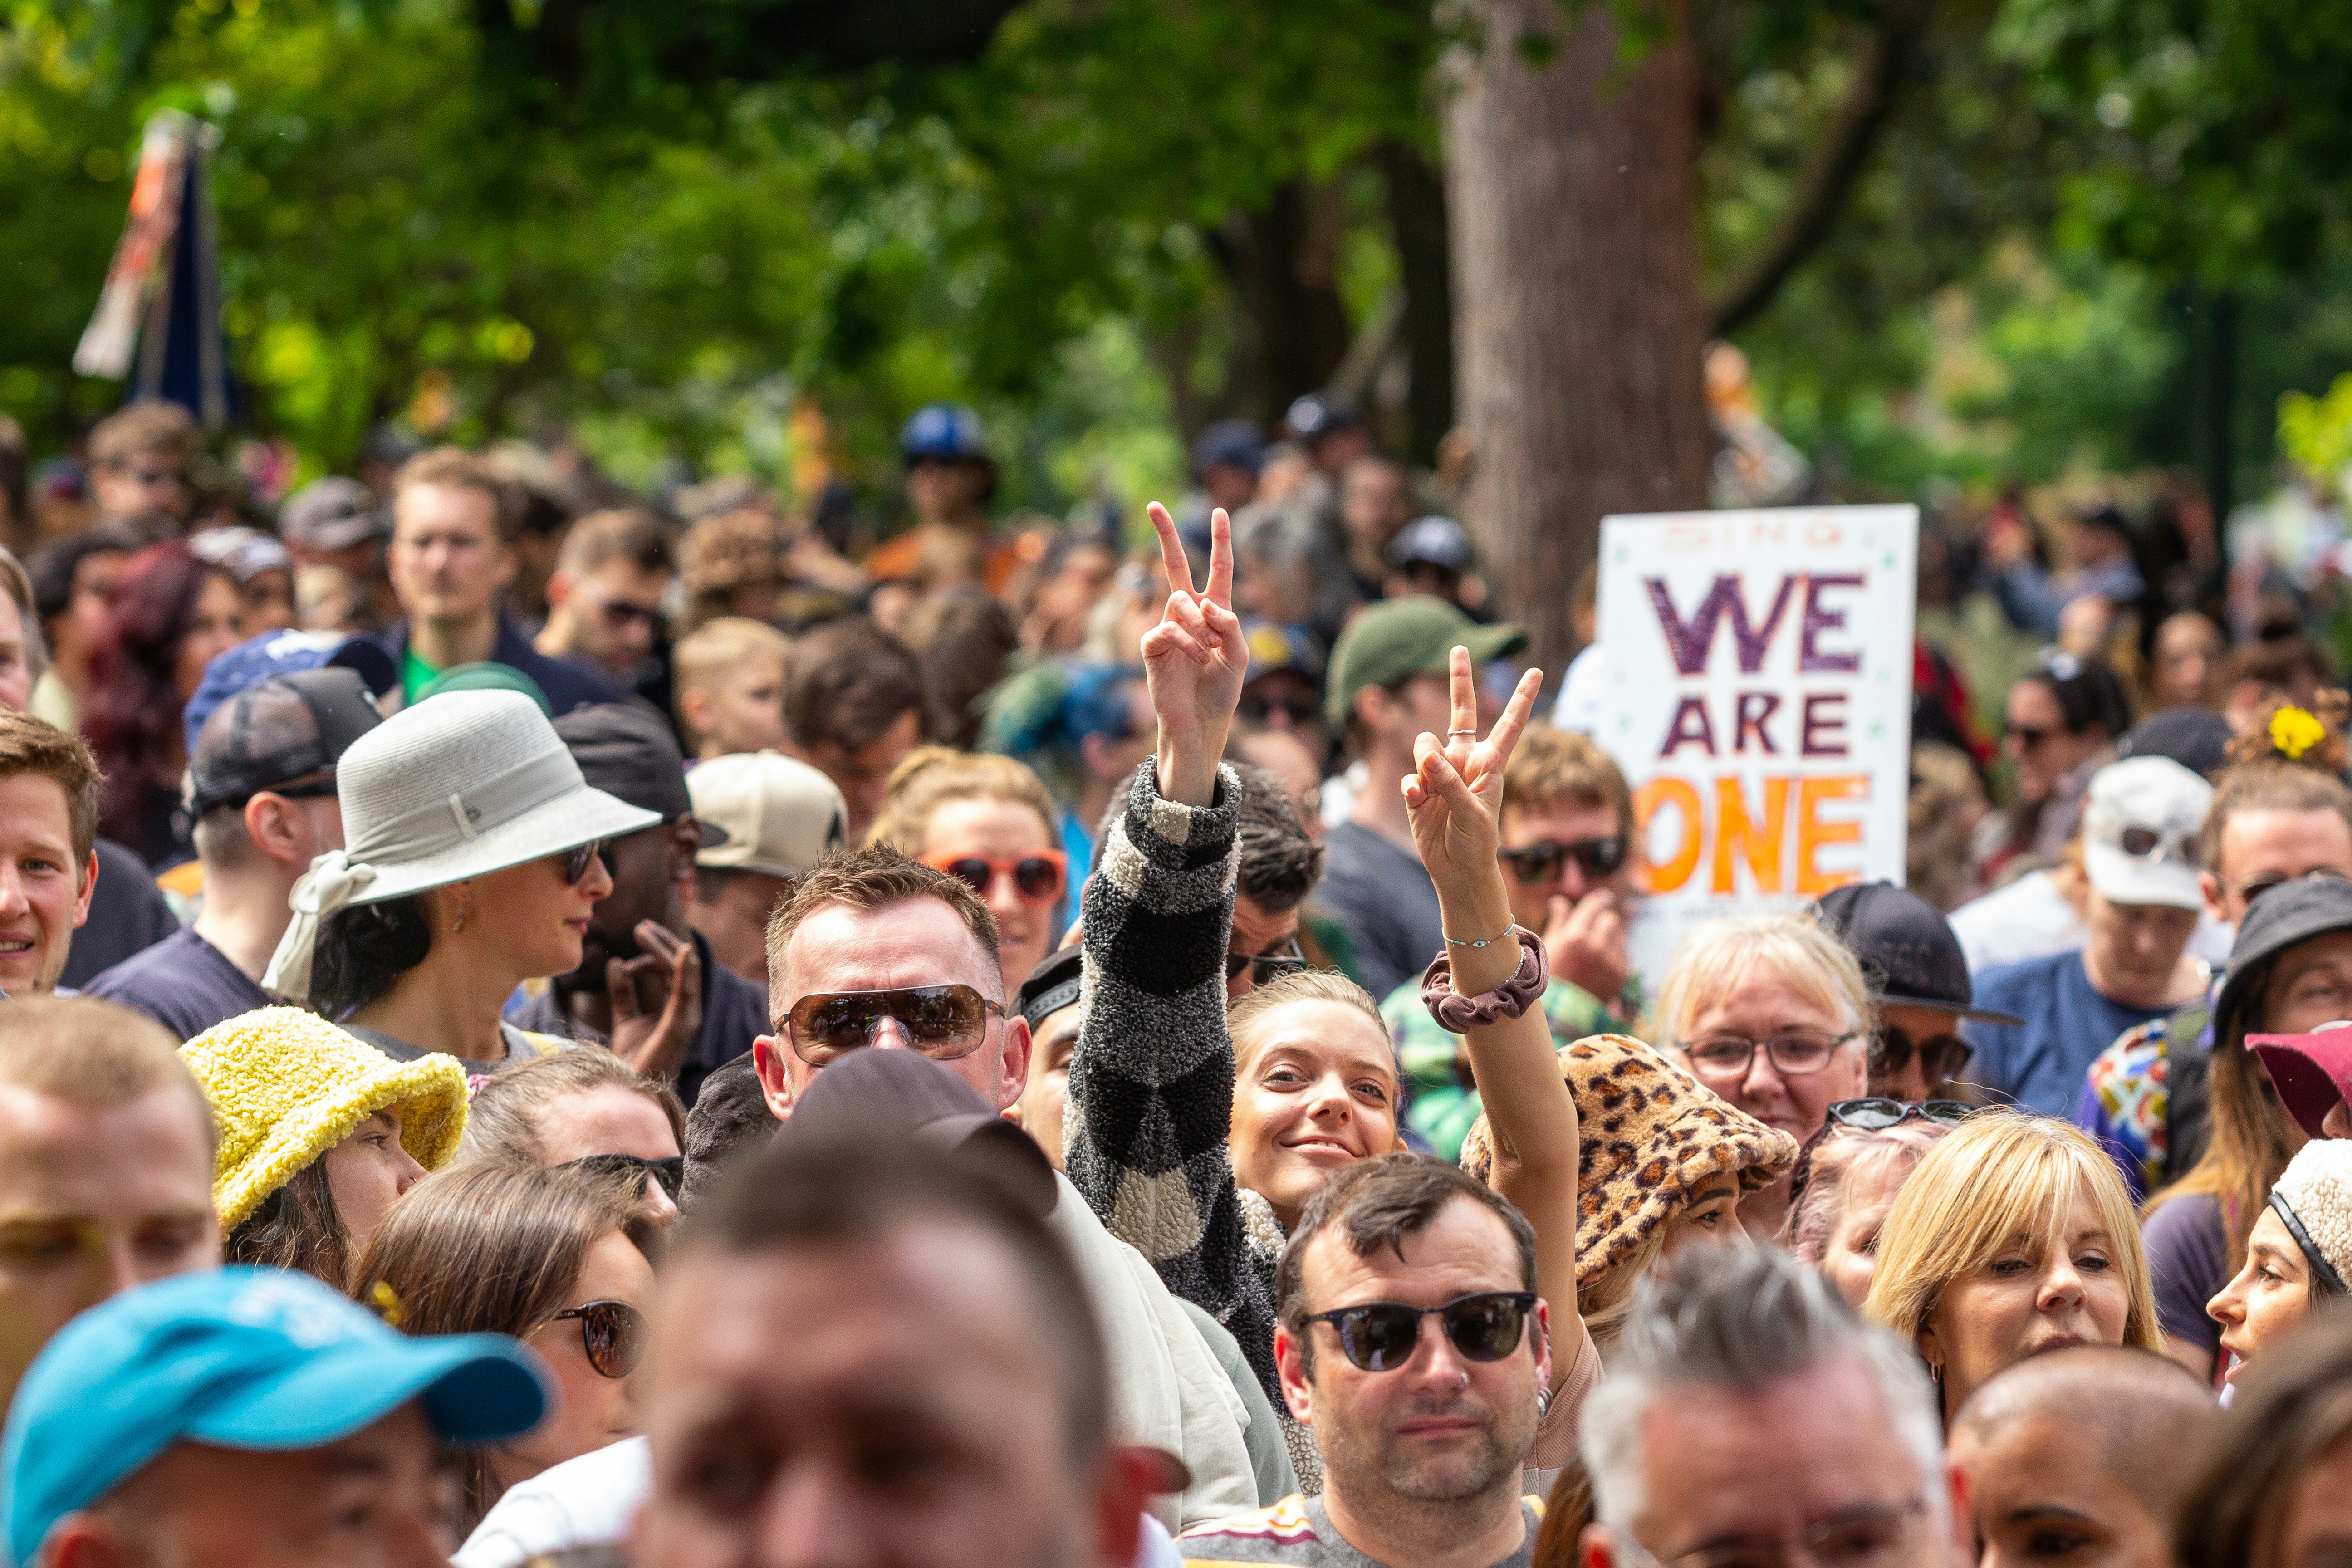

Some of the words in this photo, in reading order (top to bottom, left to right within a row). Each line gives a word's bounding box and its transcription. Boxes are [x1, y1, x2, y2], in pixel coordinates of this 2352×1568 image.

[1644, 573, 1866, 675] WE
[1660, 692, 1848, 757] ARE
[1630, 775, 1869, 897] ONE
